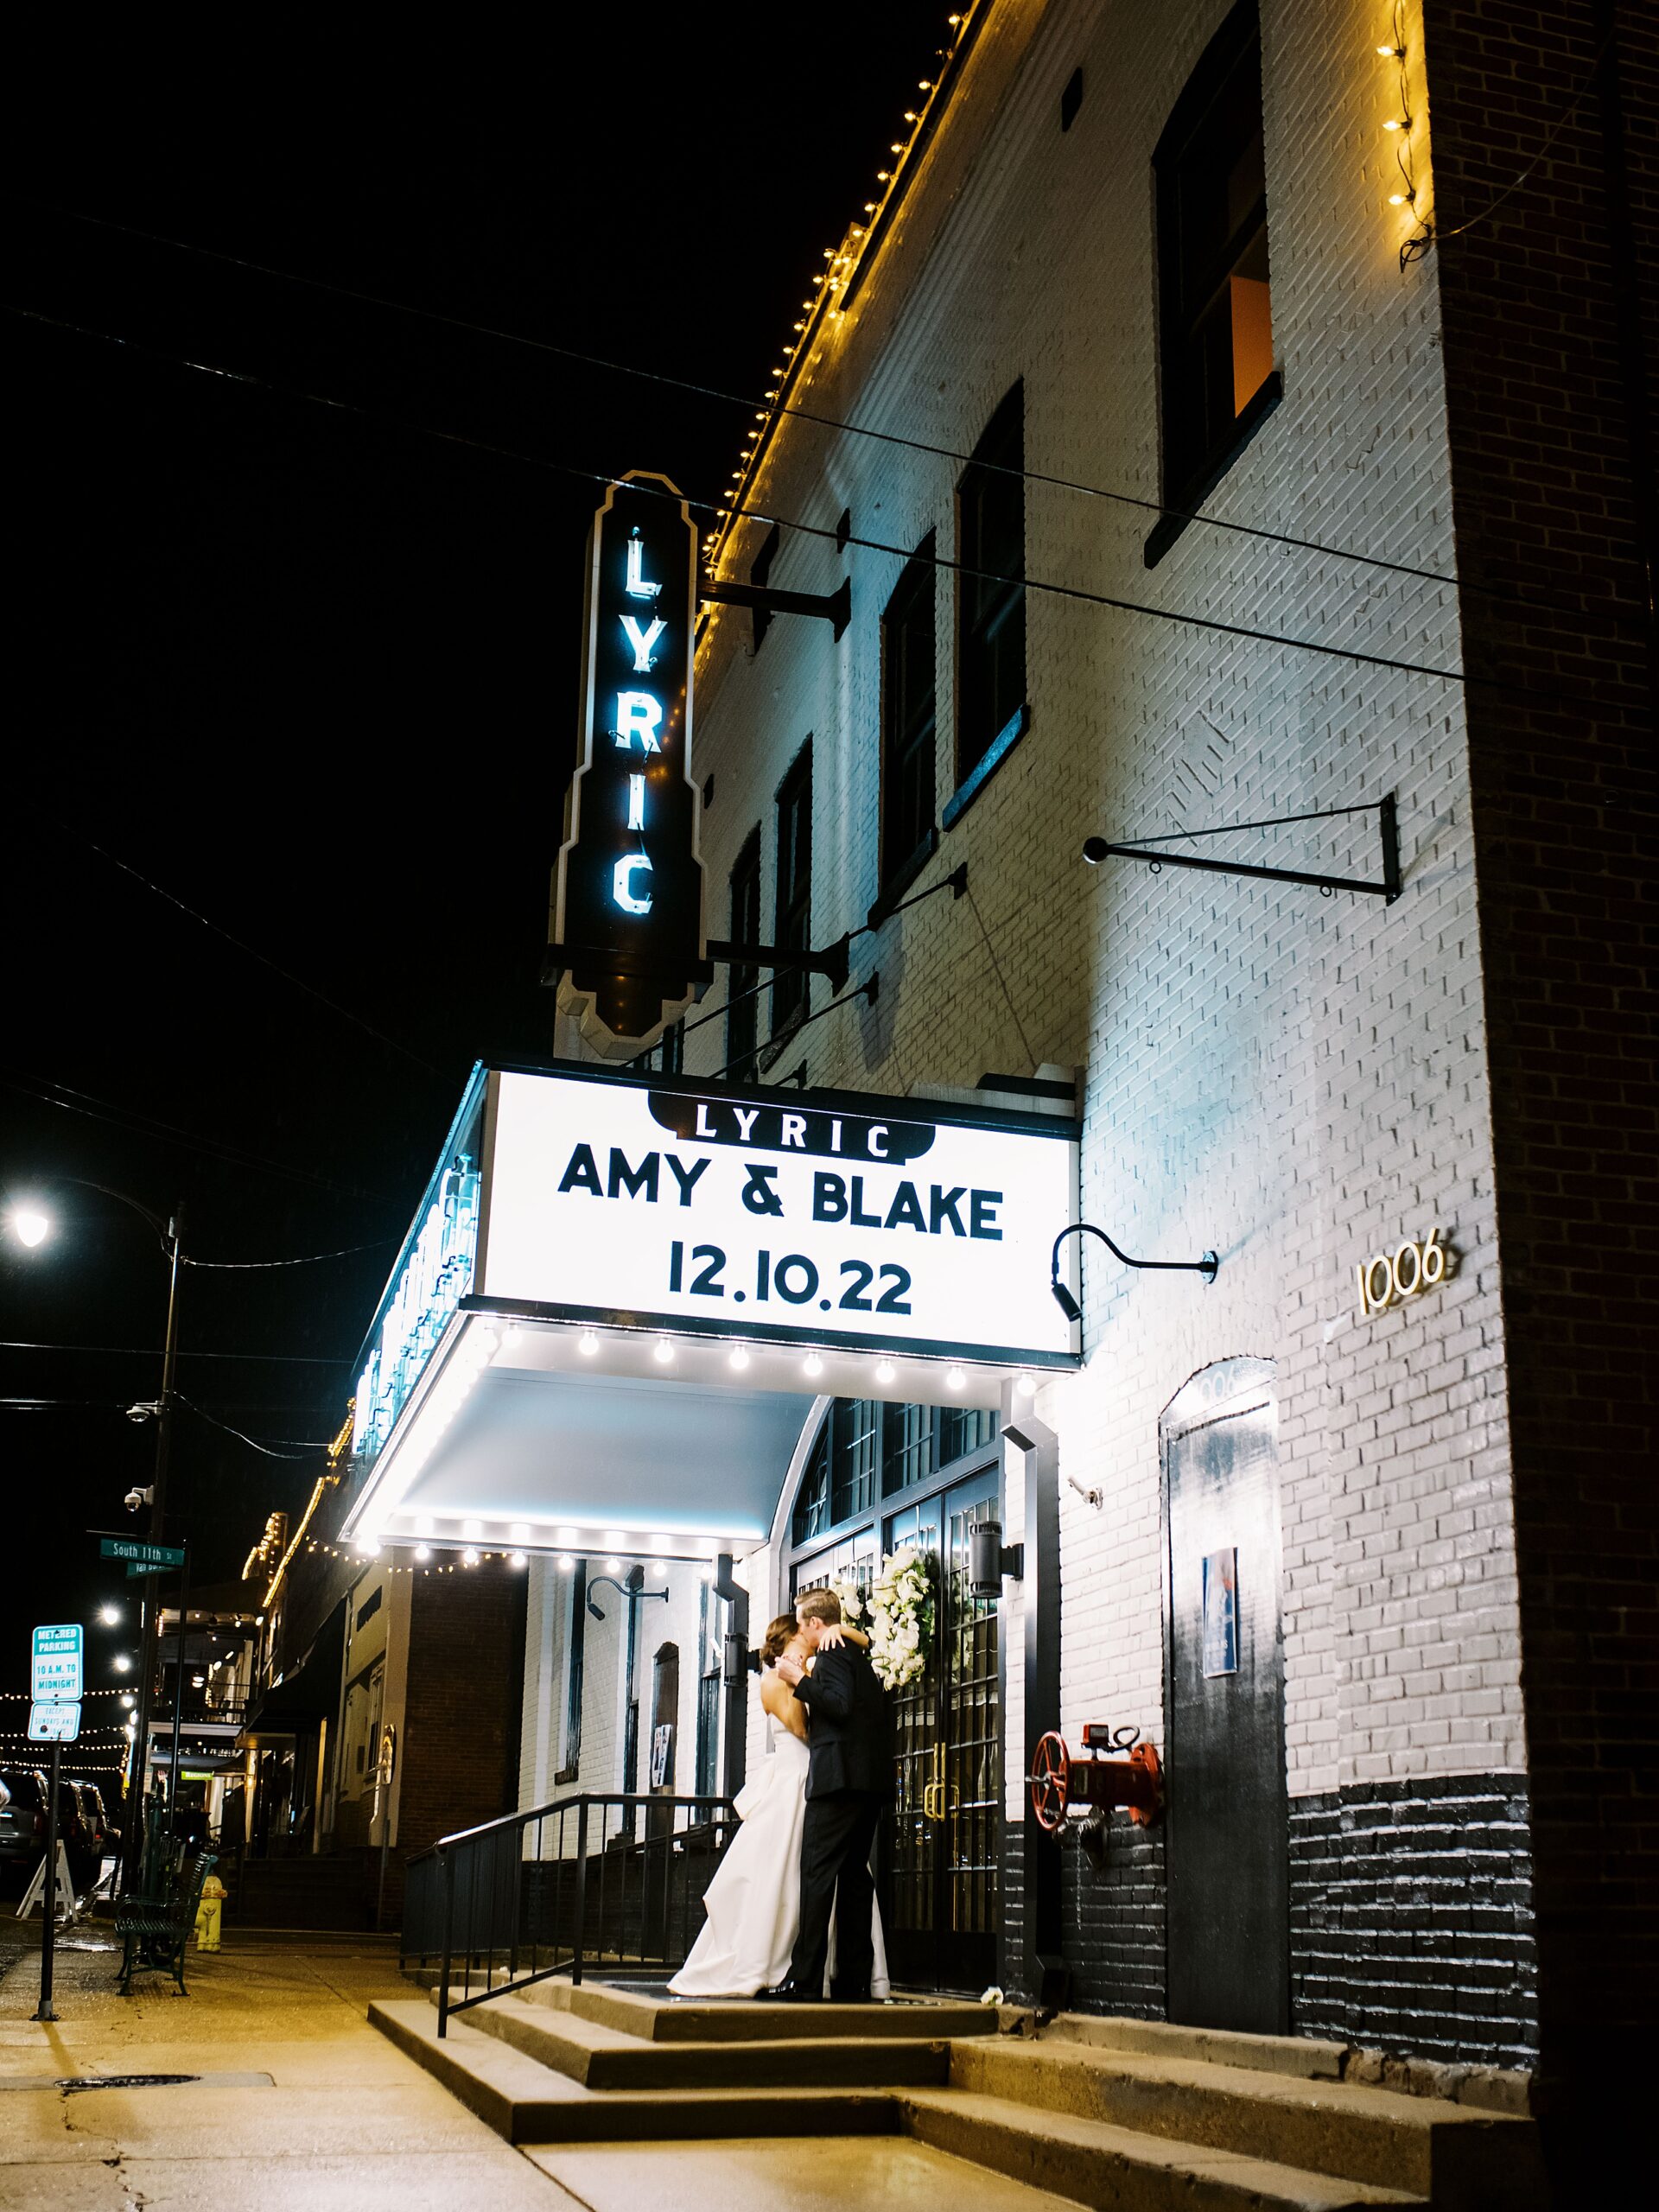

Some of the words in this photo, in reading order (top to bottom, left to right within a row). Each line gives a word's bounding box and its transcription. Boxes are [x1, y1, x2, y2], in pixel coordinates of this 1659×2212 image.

[613, 537, 668, 914] LYRIC
[696, 1104, 889, 1158] LYRIC
[557, 1142, 711, 1207] AMY
[741, 1163, 785, 1218] &
[812, 1171, 1003, 1242] BLAKE
[669, 1240, 912, 1315] 12.10.22
[1357, 1227, 1445, 1316] 1006
[113, 1542, 138, 1558] South
[143, 1547, 162, 1560] 11th
[37, 1628, 77, 1640] METERED
[39, 1640, 76, 1652] PARKING
[37, 1665, 46, 1675] 10
[67, 1663, 76, 1673] TO
[38, 1679, 76, 1689] MIDNIGHT
